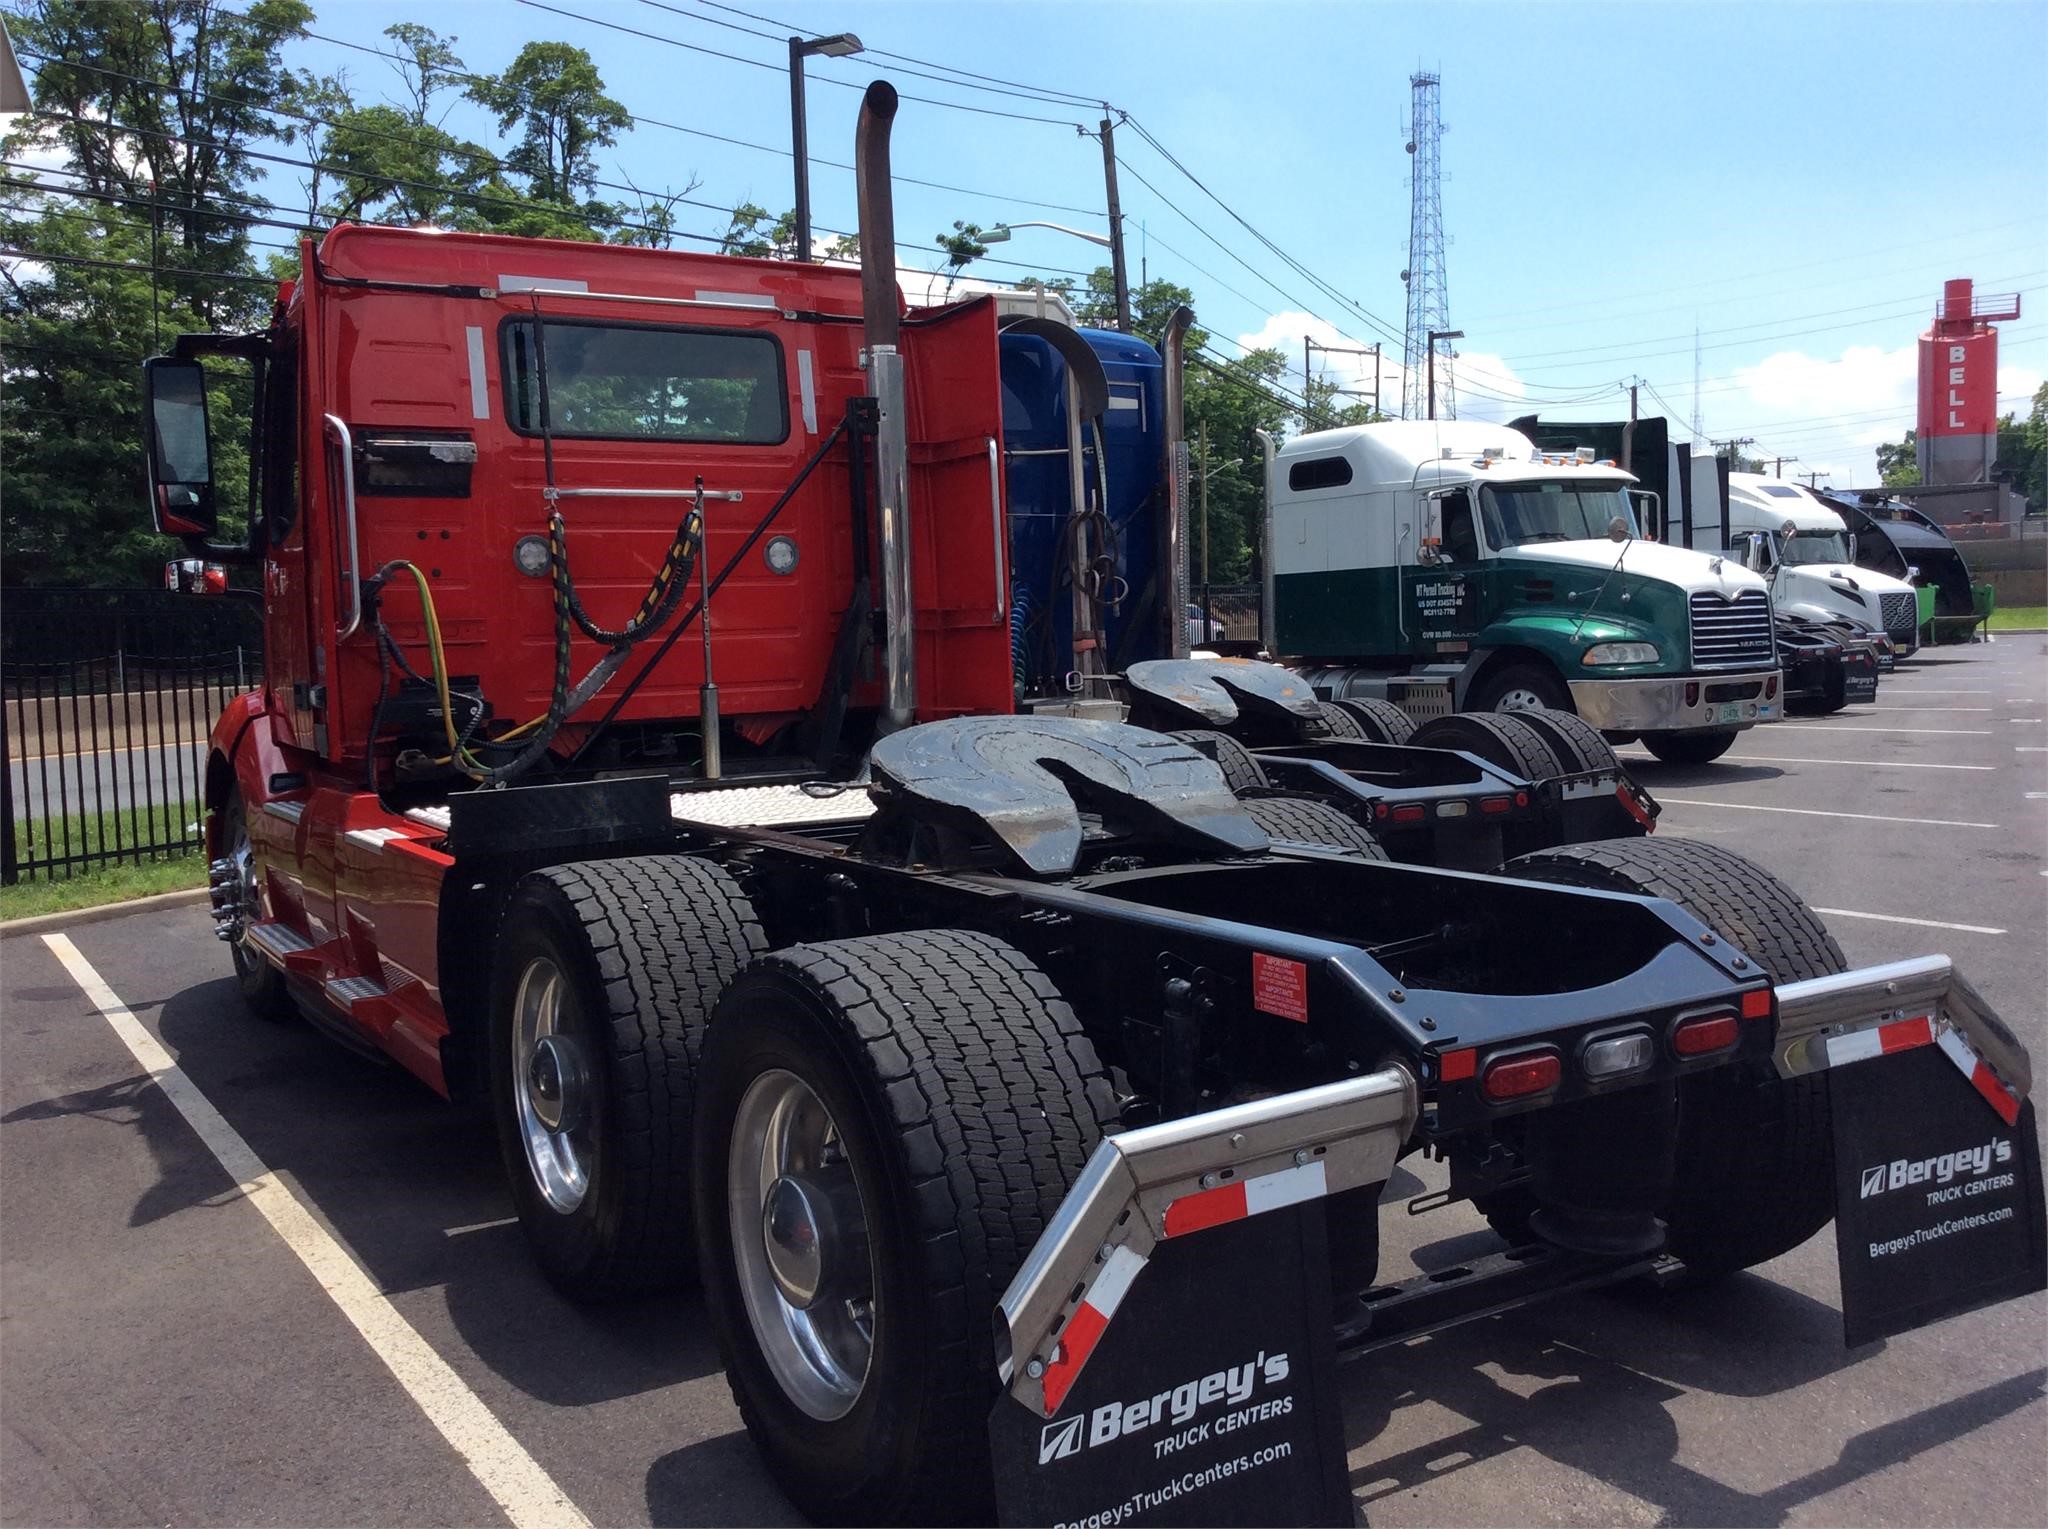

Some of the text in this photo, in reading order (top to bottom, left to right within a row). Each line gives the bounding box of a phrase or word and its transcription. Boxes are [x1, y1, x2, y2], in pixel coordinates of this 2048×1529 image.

[1949, 346, 1966, 428] BELL
[1889, 1137, 2012, 1191] Bergey's
[1926, 1173, 2015, 1206] TRUCK CENTERS
[1869, 1206, 2013, 1258] BergeysTruckCenters.com
[1089, 1350, 1290, 1448] Bergey's
[1154, 1396, 1293, 1460] TRUCK CENTERS
